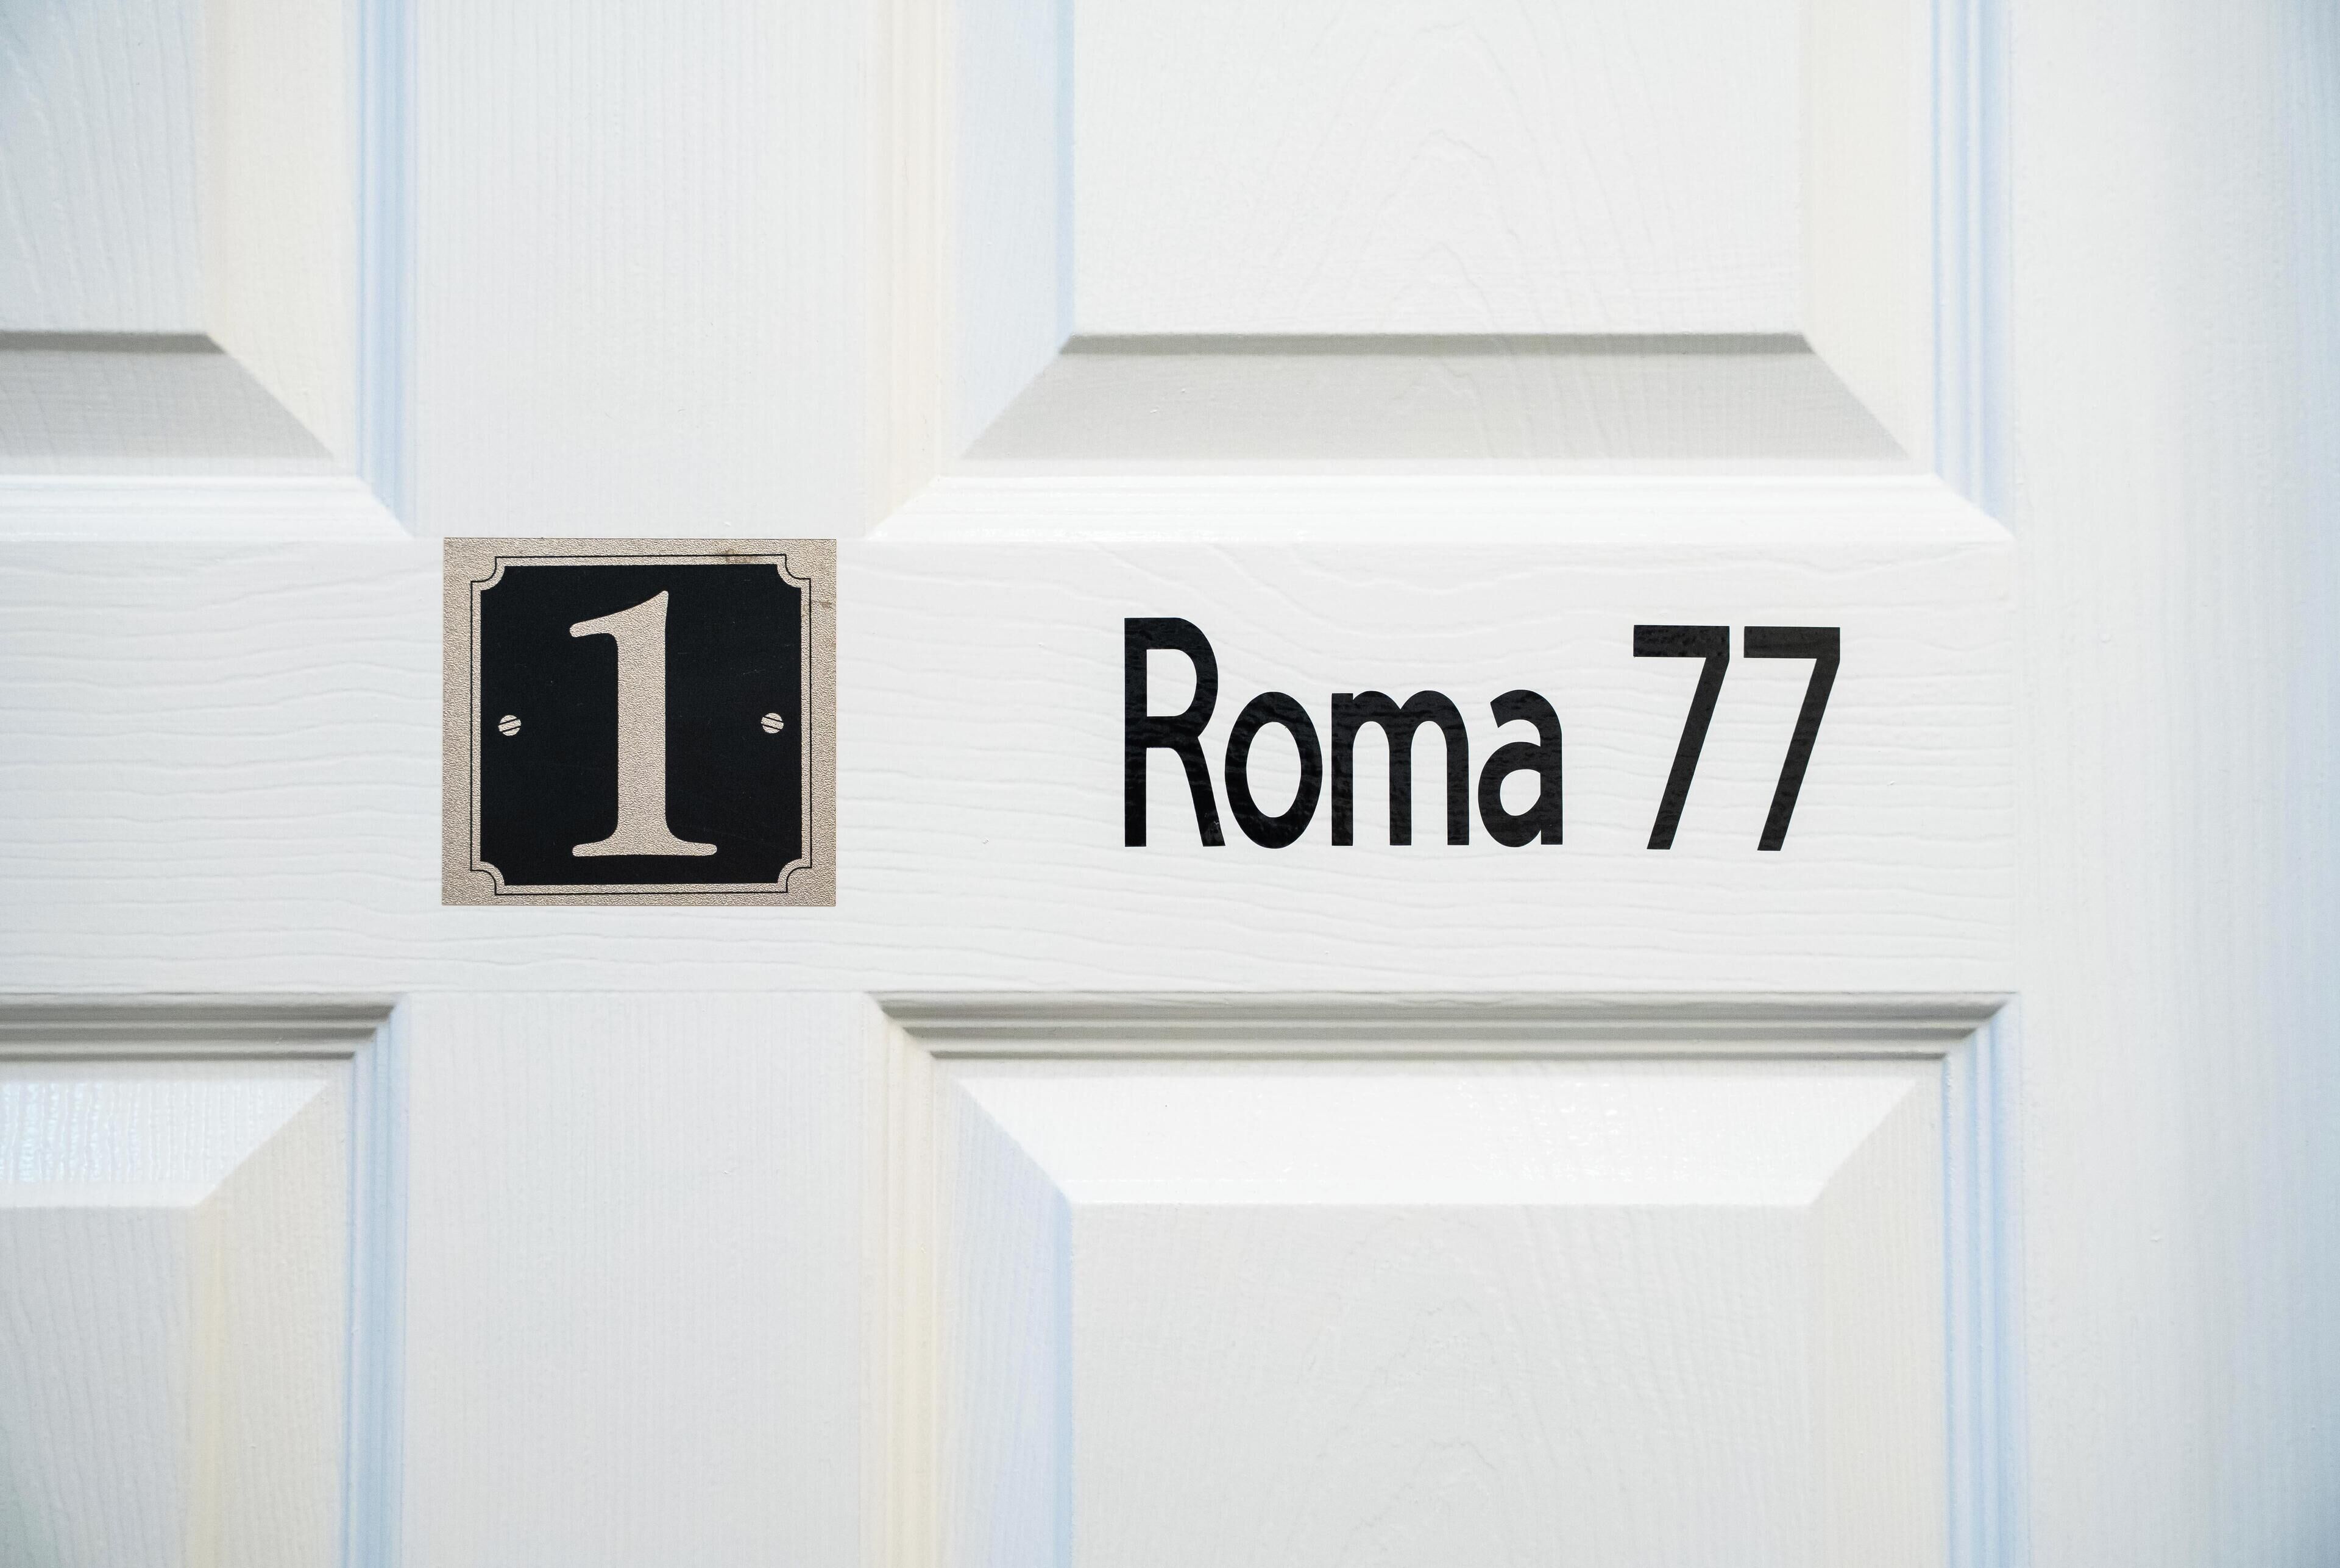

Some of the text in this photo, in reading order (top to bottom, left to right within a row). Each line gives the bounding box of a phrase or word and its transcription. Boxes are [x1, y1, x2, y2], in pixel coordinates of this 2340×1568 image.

[569, 590, 718, 857] 1
[1124, 617, 1841, 851] Roma 77
